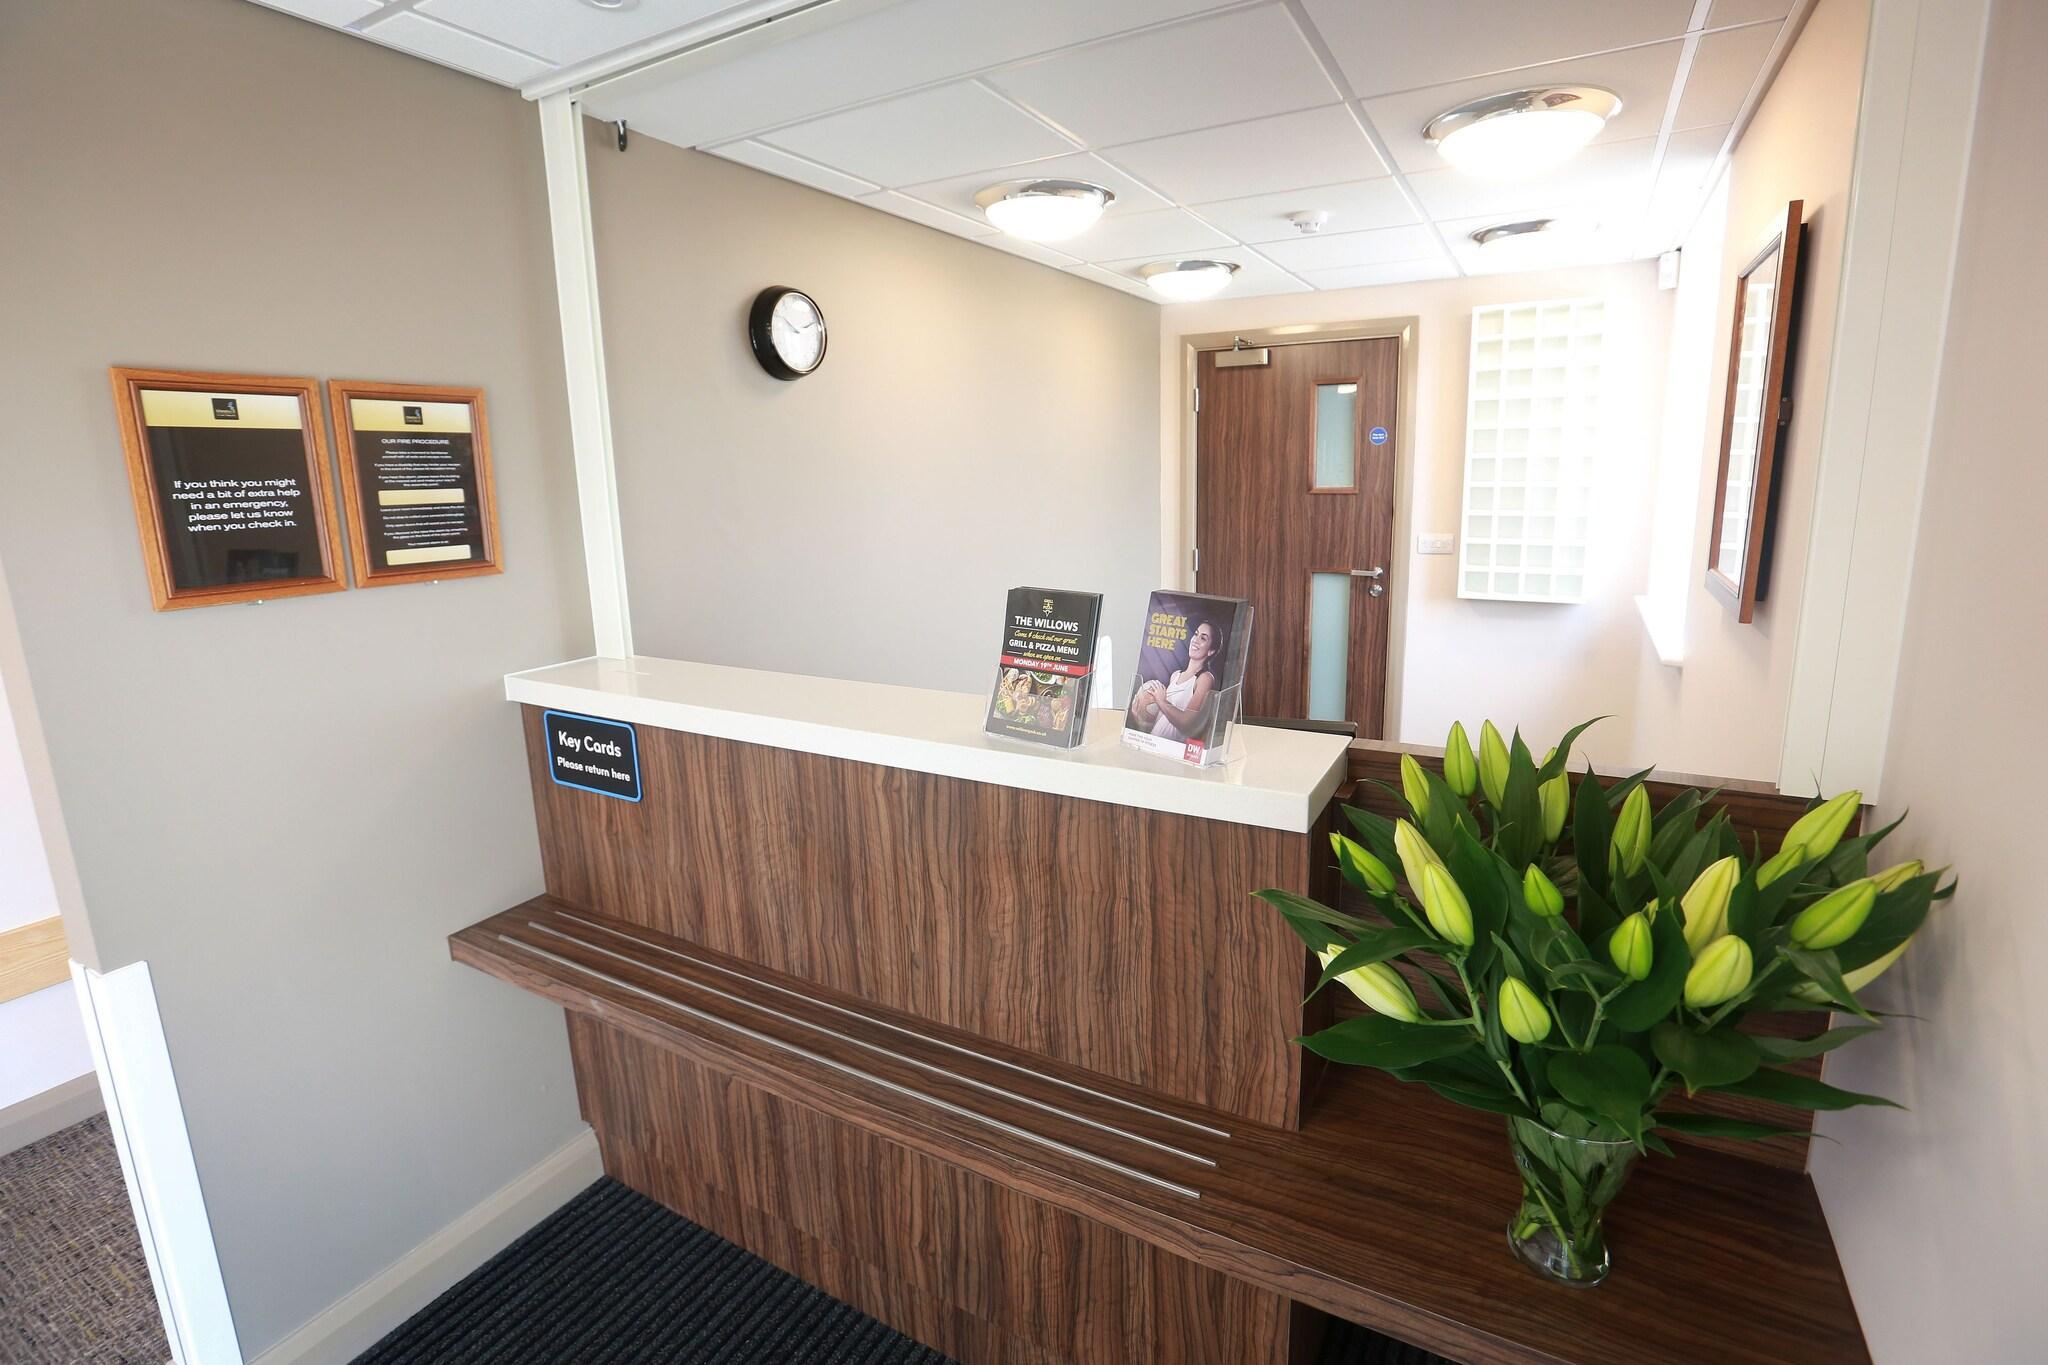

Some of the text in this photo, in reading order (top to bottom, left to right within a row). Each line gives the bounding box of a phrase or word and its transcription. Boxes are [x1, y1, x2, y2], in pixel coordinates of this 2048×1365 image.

[174, 479, 296, 490] If you think you might
[172, 491, 205, 500] need
[217, 490, 232, 499] bit
[234, 490, 245, 498] of
[247, 490, 275, 498] extra
[276, 489, 301, 497] help
[190, 502, 202, 510] in
[188, 513, 228, 522] please
[230, 511, 245, 519] let
[263, 510, 294, 518] know
[187, 519, 297, 532] when you check in.
[1014, 615, 1079, 632] THE WILLOWS
[1151, 612, 1188, 628] GREAT
[1014, 630, 1028, 638] Come
[1031, 631, 1045, 641] check
[1148, 624, 1188, 640] STARTS
[1008, 639, 1079, 655] GRILL & PIZZA MENU
[1147, 635, 1176, 650] HERE
[1022, 650, 1036, 658] when
[1042, 653, 1054, 661] open
[1013, 658, 1040, 668] MONDAY
[1052, 663, 1069, 672] JUNE
[558, 730, 622, 757] Key Cards
[557, 756, 631, 782] Please return here
